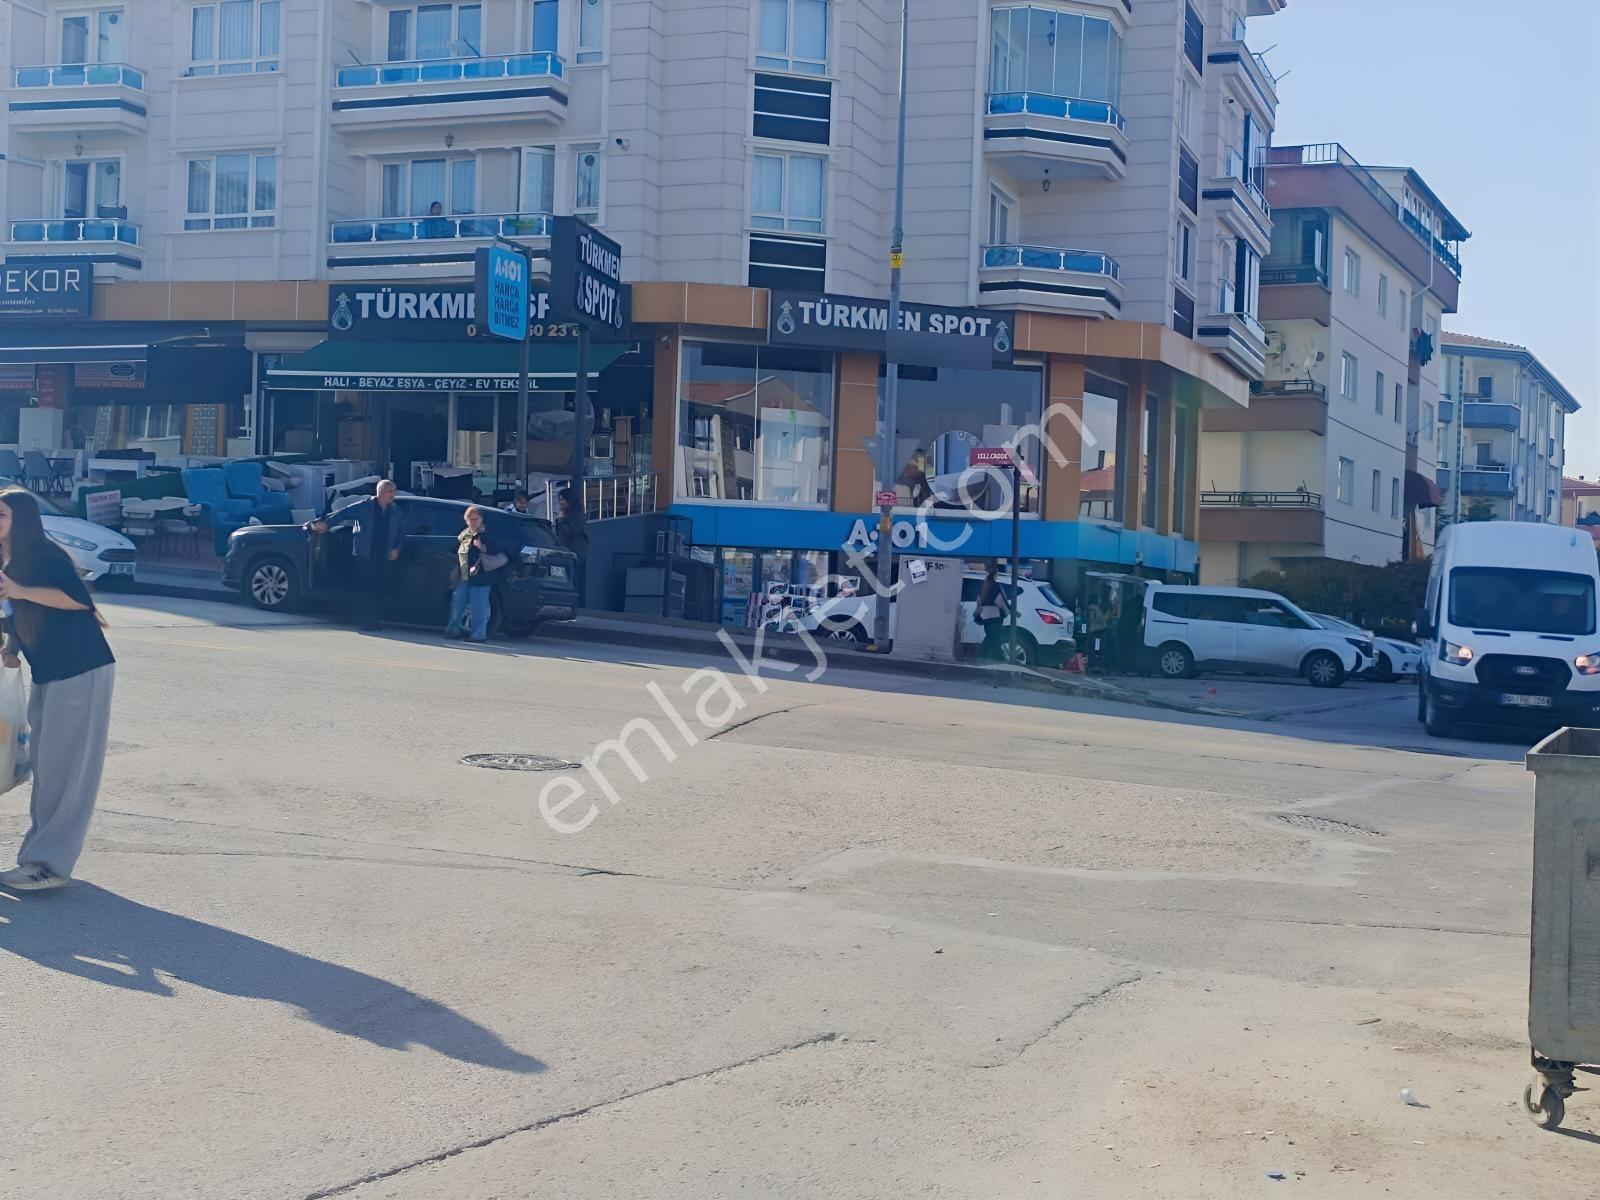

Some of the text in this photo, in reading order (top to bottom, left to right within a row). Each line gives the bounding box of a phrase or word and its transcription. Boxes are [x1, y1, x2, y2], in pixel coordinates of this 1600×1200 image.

[0, 269, 81, 292] EKOR
[584, 275, 616, 324] SPOT
[928, 313, 991, 337] SPOT
[324, 377, 350, 388] HALI
[360, 377, 394, 388] BEYAZ
[476, 379, 491, 389] EV
[493, 379, 540, 389] TEKSİL
